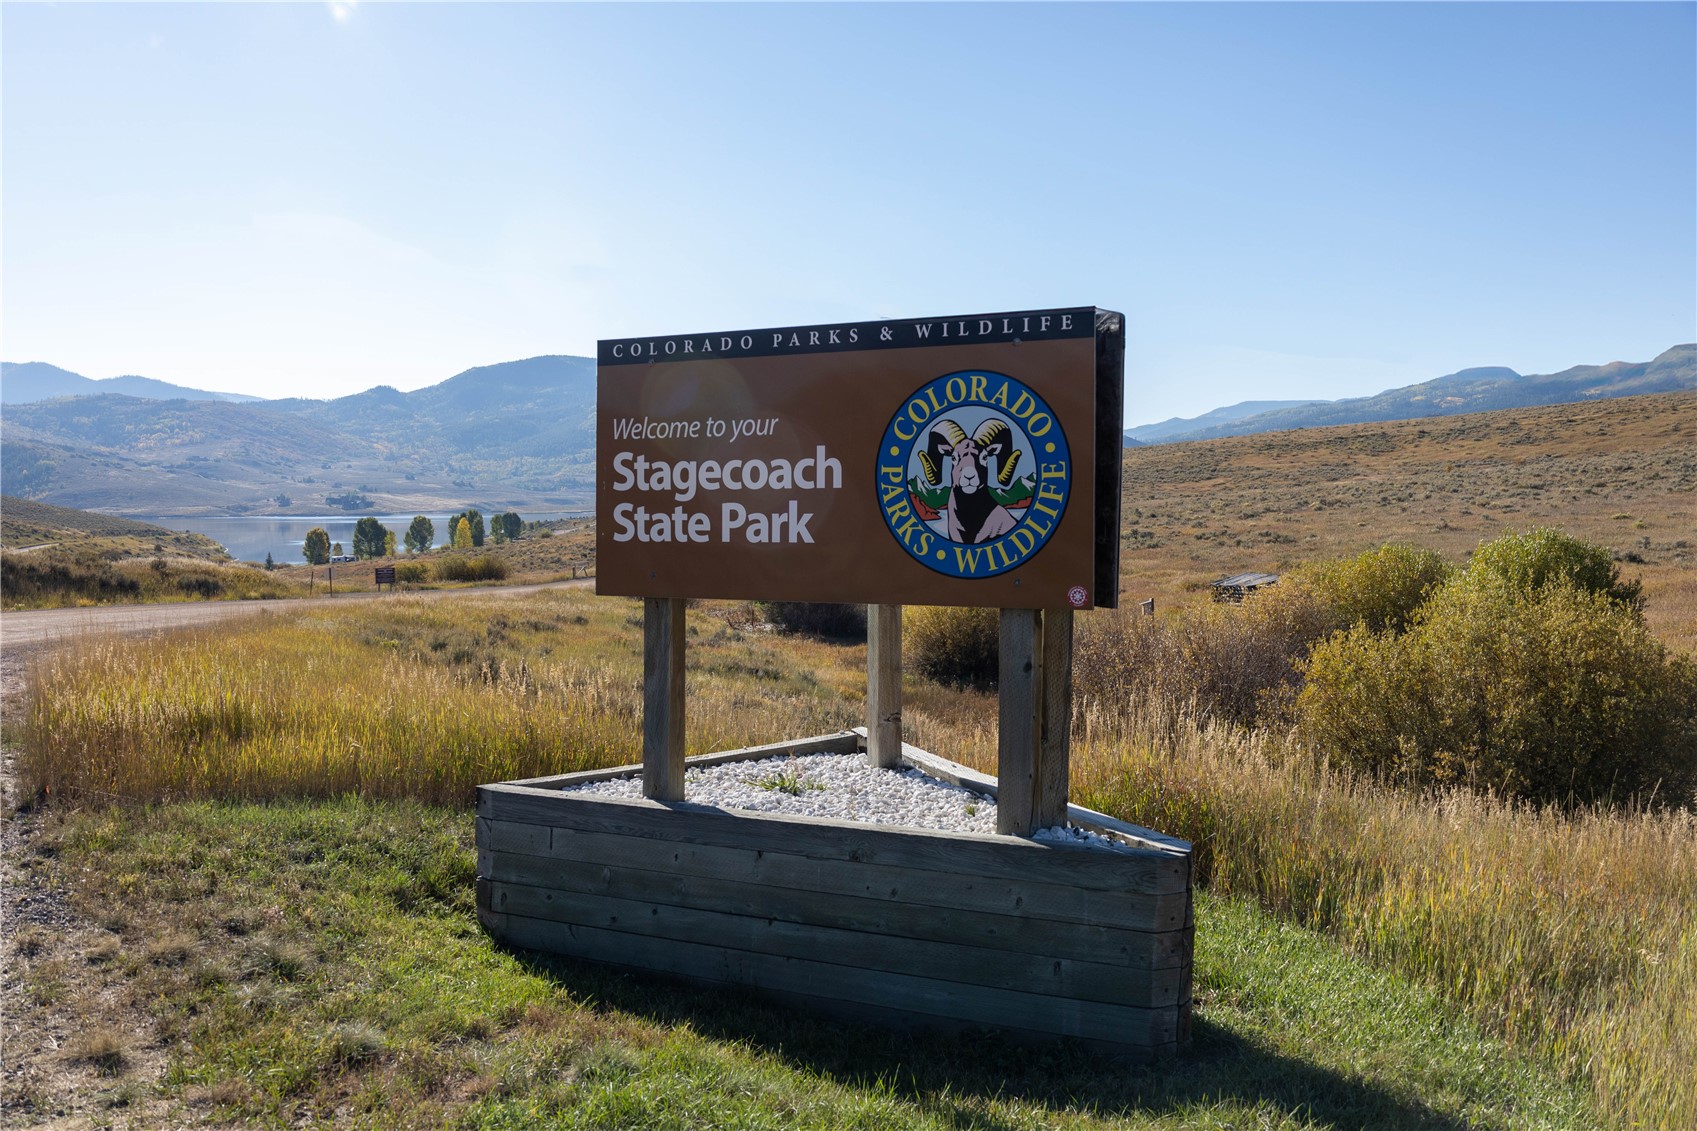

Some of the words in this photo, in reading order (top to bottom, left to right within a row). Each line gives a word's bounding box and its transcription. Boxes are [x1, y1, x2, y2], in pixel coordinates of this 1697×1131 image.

[612, 335, 753, 358] COLORADO
[772, 328, 859, 348] PARKS
[879, 326, 893, 341] &
[915, 314, 1073, 339] WILDLIFE
[613, 416, 700, 440] Welcome
[706, 417, 726, 437] to
[729, 417, 779, 443] your
[893, 375, 1053, 441] COLORADO
[612, 445, 843, 502] Stagecoach
[612, 502, 711, 543] State
[721, 500, 815, 544] Park
[881, 464, 934, 557] PARKS
[953, 460, 1067, 574] WILDLIFE
